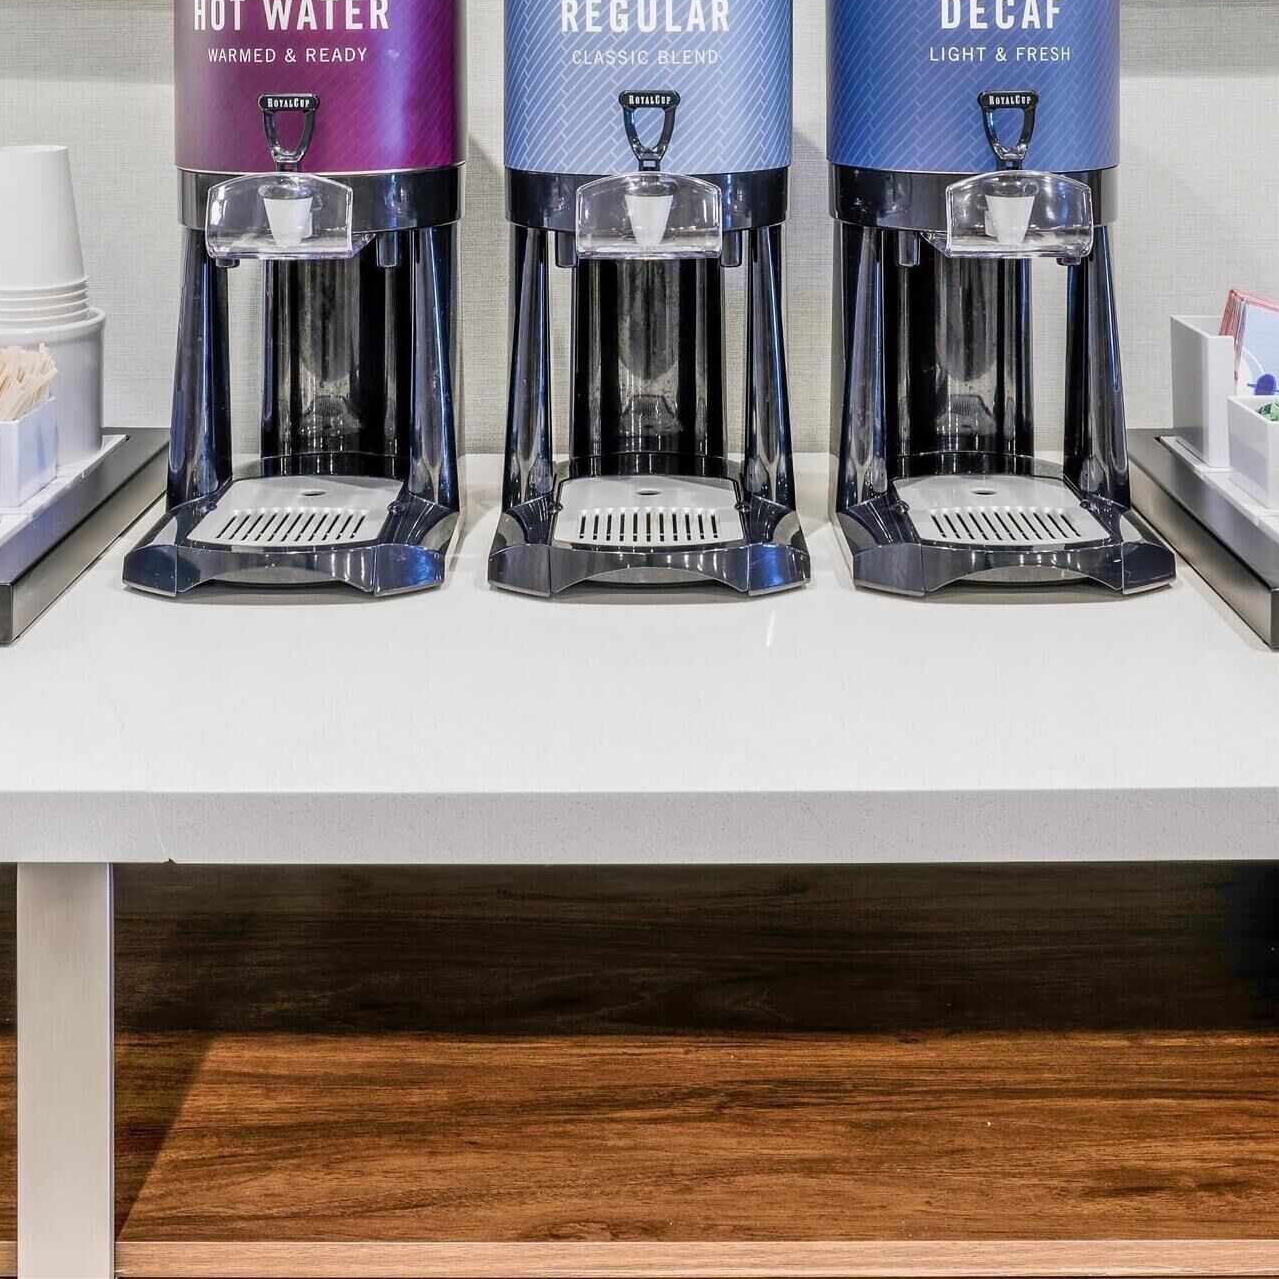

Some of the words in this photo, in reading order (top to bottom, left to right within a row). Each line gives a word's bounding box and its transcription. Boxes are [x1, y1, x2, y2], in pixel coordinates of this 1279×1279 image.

[207, 48, 277, 63] WARMED
[284, 48, 297, 63] &
[305, 47, 367, 63] READY
[572, 50, 649, 65] CLASSIC
[658, 50, 719, 65] BLEND
[929, 46, 987, 62] LIGHT
[995, 46, 1007, 62] &
[1016, 46, 1071, 62] FRESH
